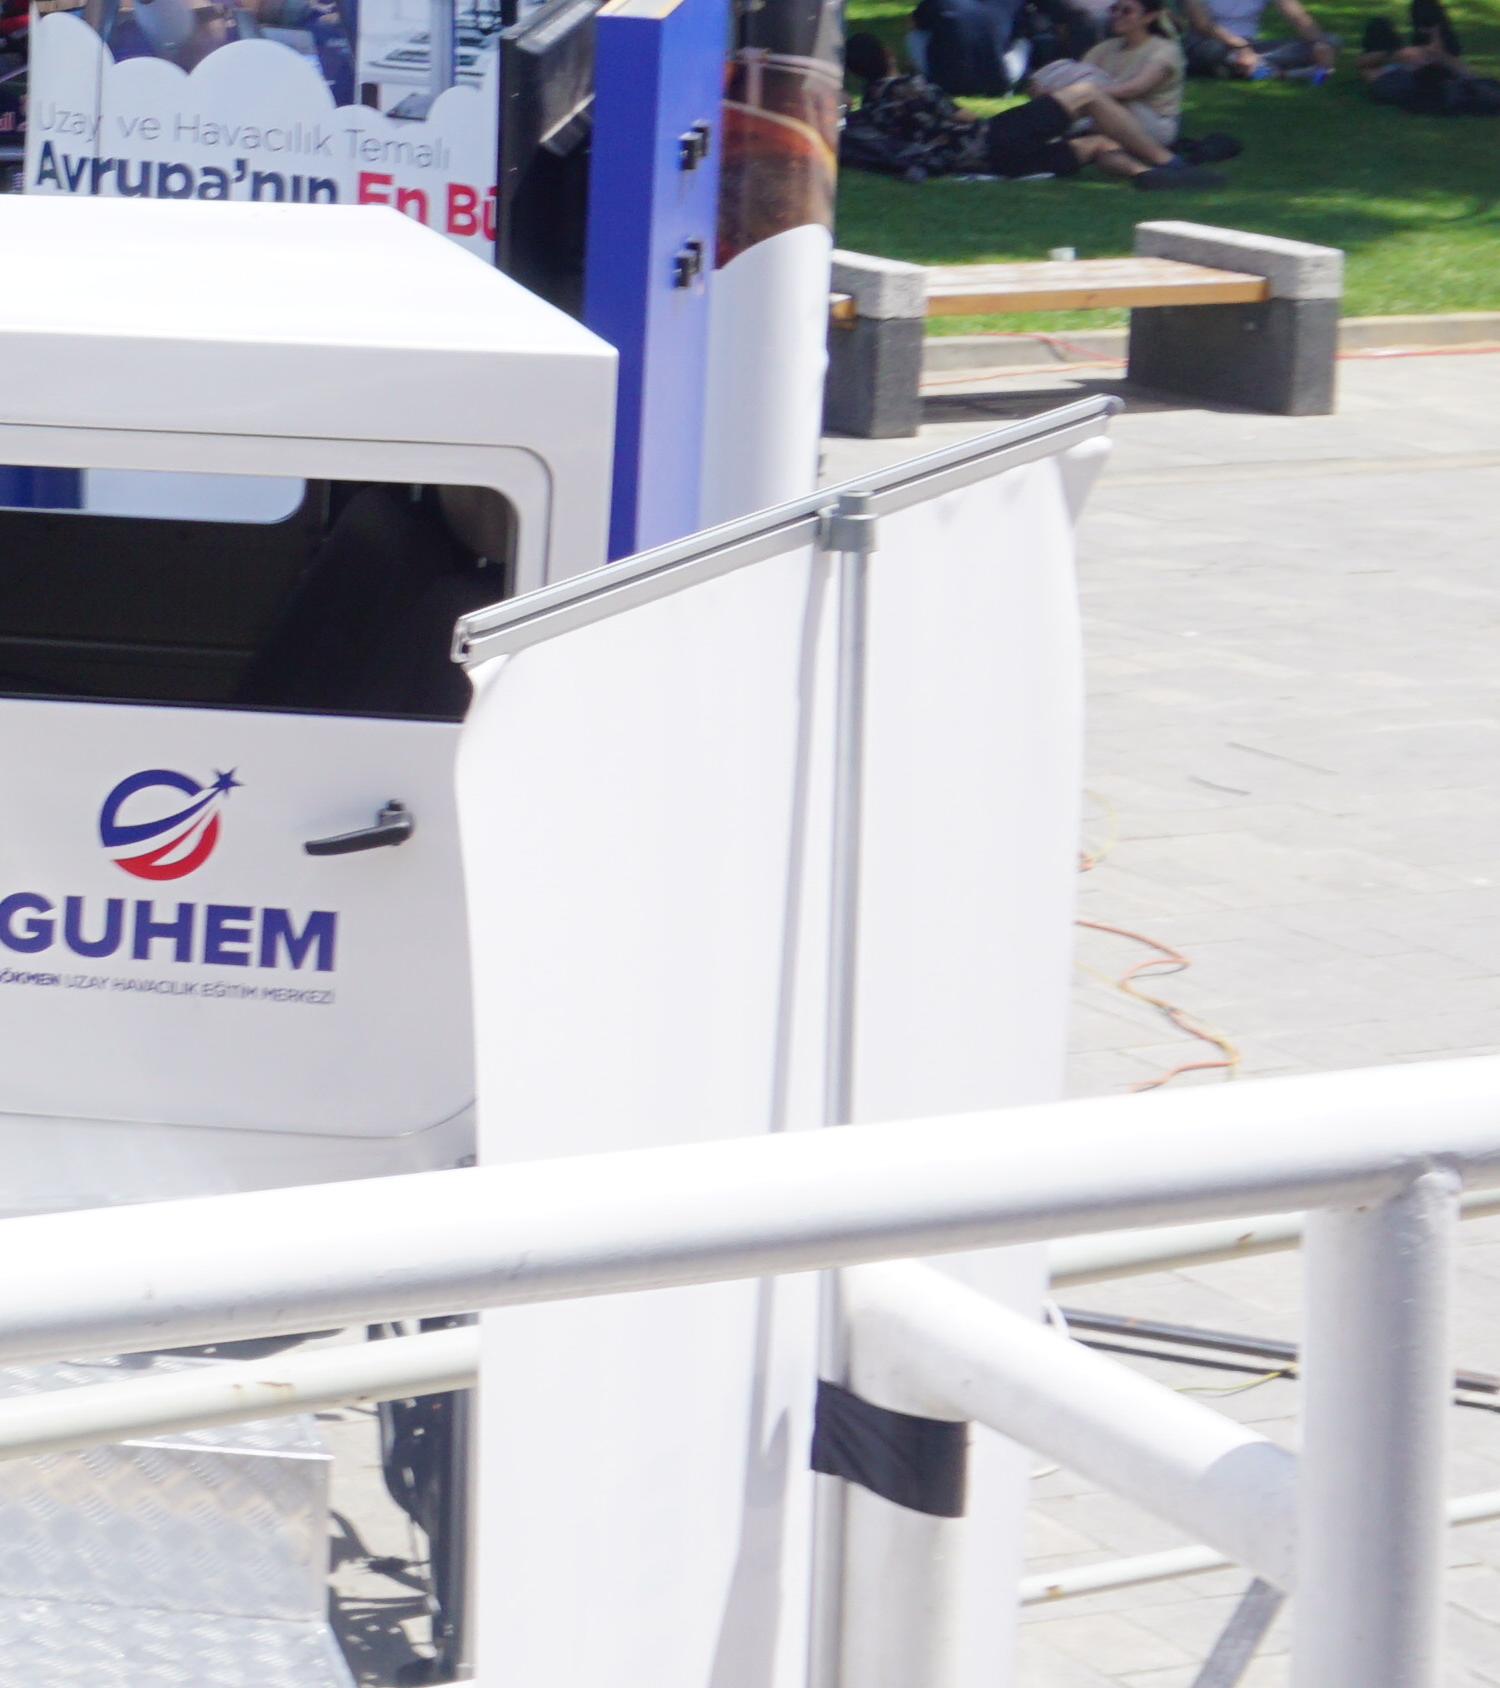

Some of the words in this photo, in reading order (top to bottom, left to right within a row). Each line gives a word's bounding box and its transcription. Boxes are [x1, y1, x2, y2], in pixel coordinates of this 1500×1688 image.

[37, 102, 103, 143] Uzay
[116, 115, 161, 141] ve
[173, 112, 333, 158] Havacılık
[344, 128, 449, 170] Temalı
[358, 170, 429, 226] En
